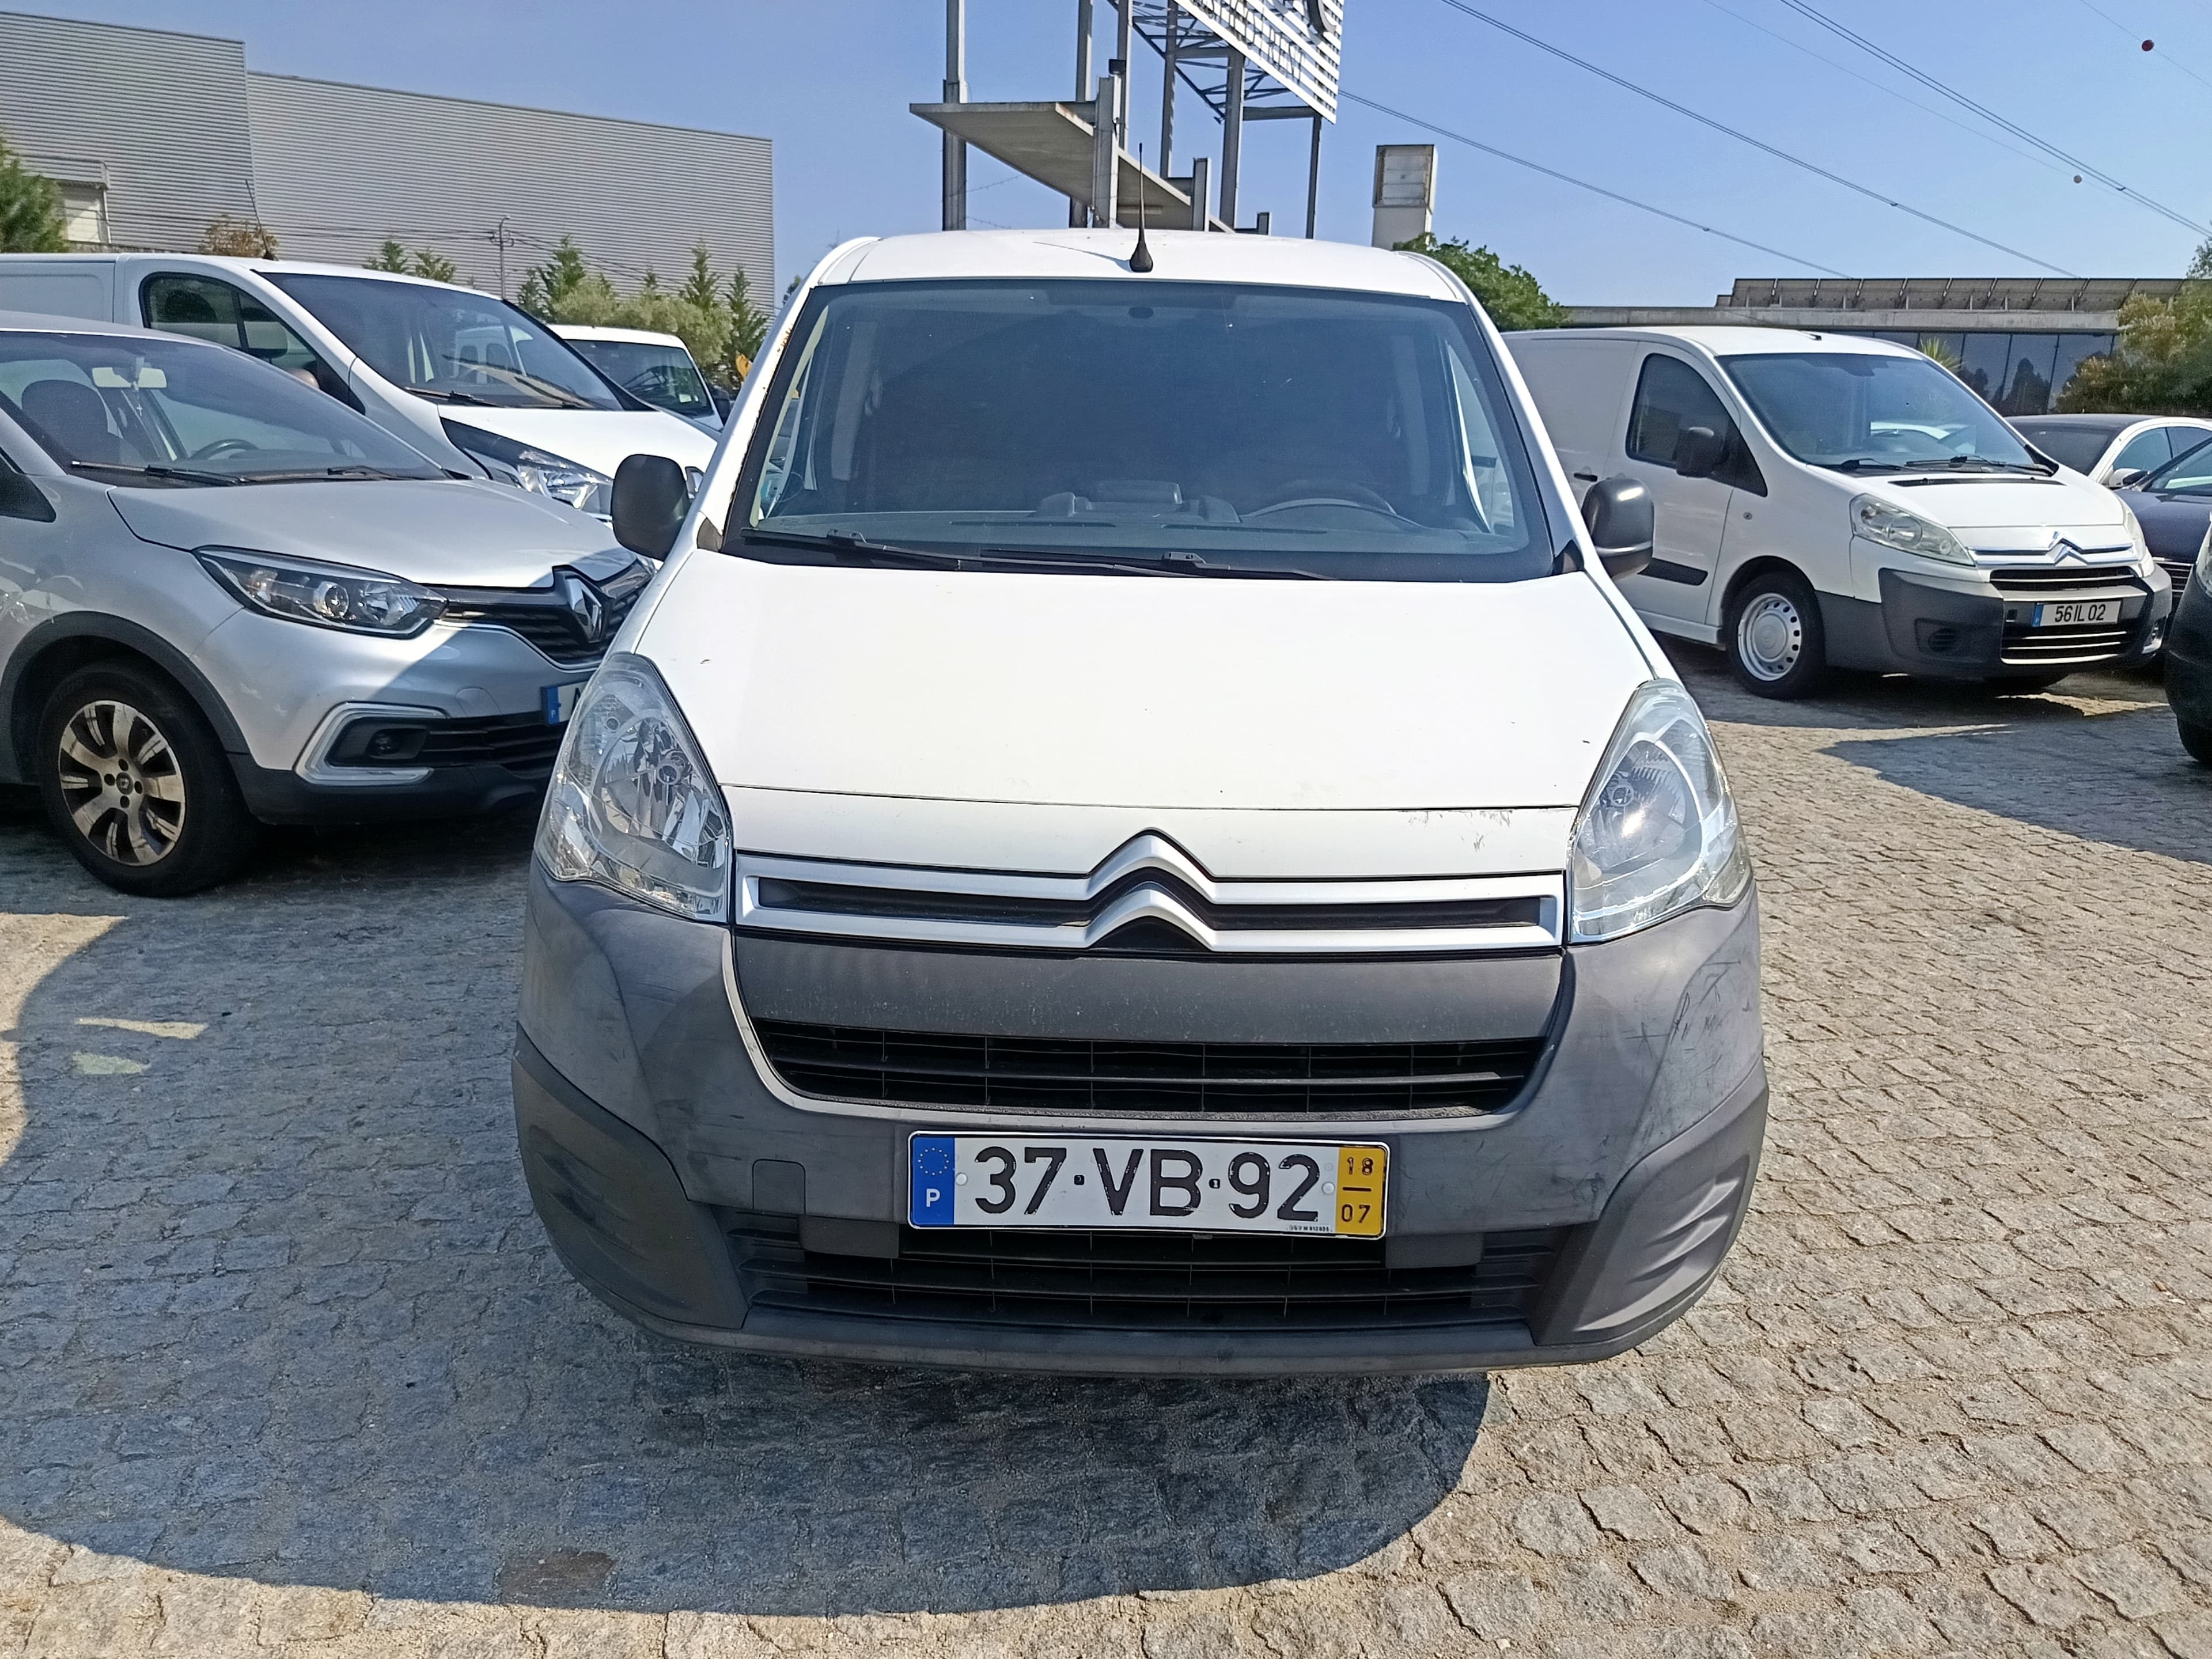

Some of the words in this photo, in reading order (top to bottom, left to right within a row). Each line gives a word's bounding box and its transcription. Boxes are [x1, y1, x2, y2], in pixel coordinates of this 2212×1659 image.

[2088, 604, 2106, 621] 02
[551, 710, 556, 718] P
[1346, 1157, 1374, 1176] 18
[925, 1188, 941, 1207] P
[1341, 1204, 1372, 1223] 07
